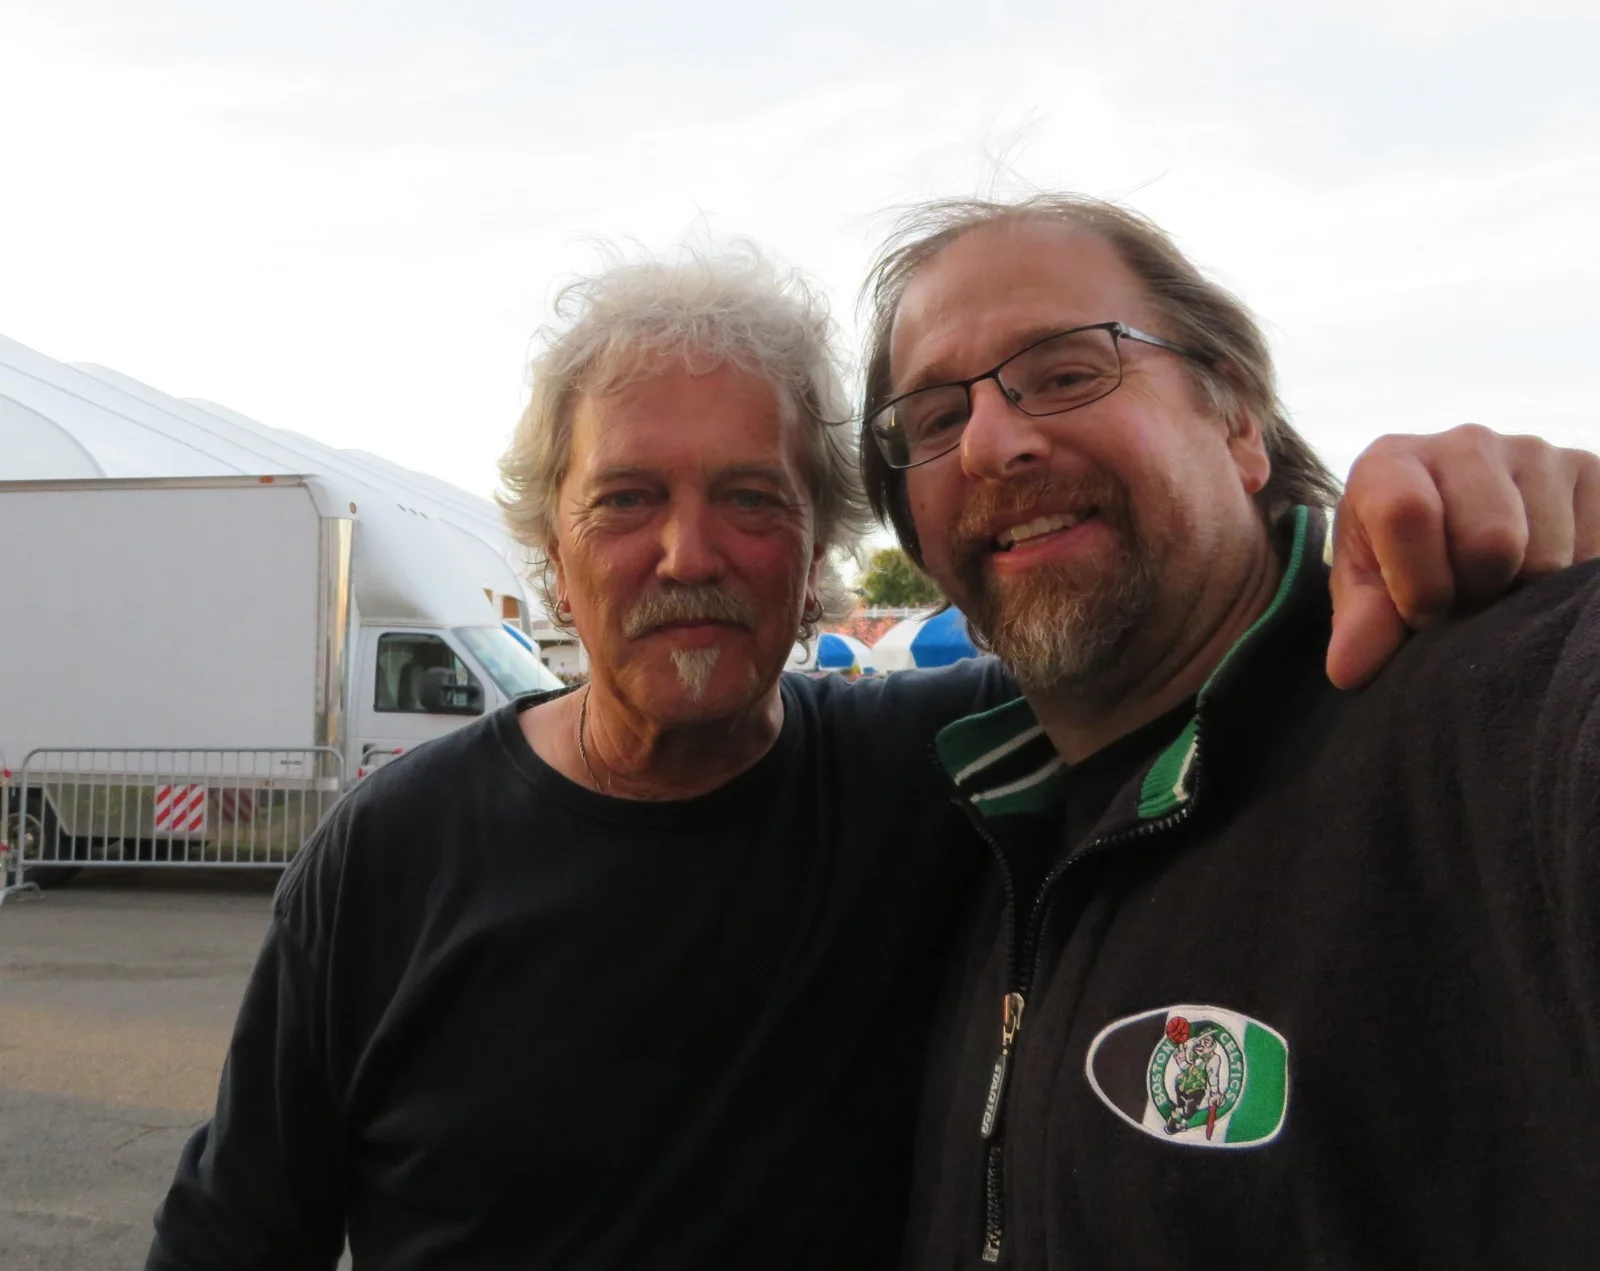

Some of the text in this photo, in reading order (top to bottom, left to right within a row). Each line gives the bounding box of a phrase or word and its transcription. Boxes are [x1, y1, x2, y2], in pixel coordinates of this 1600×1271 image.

[981, 1063, 1002, 1135] STARTER
[1151, 1032, 1242, 1107] BOSTON CELTICS
